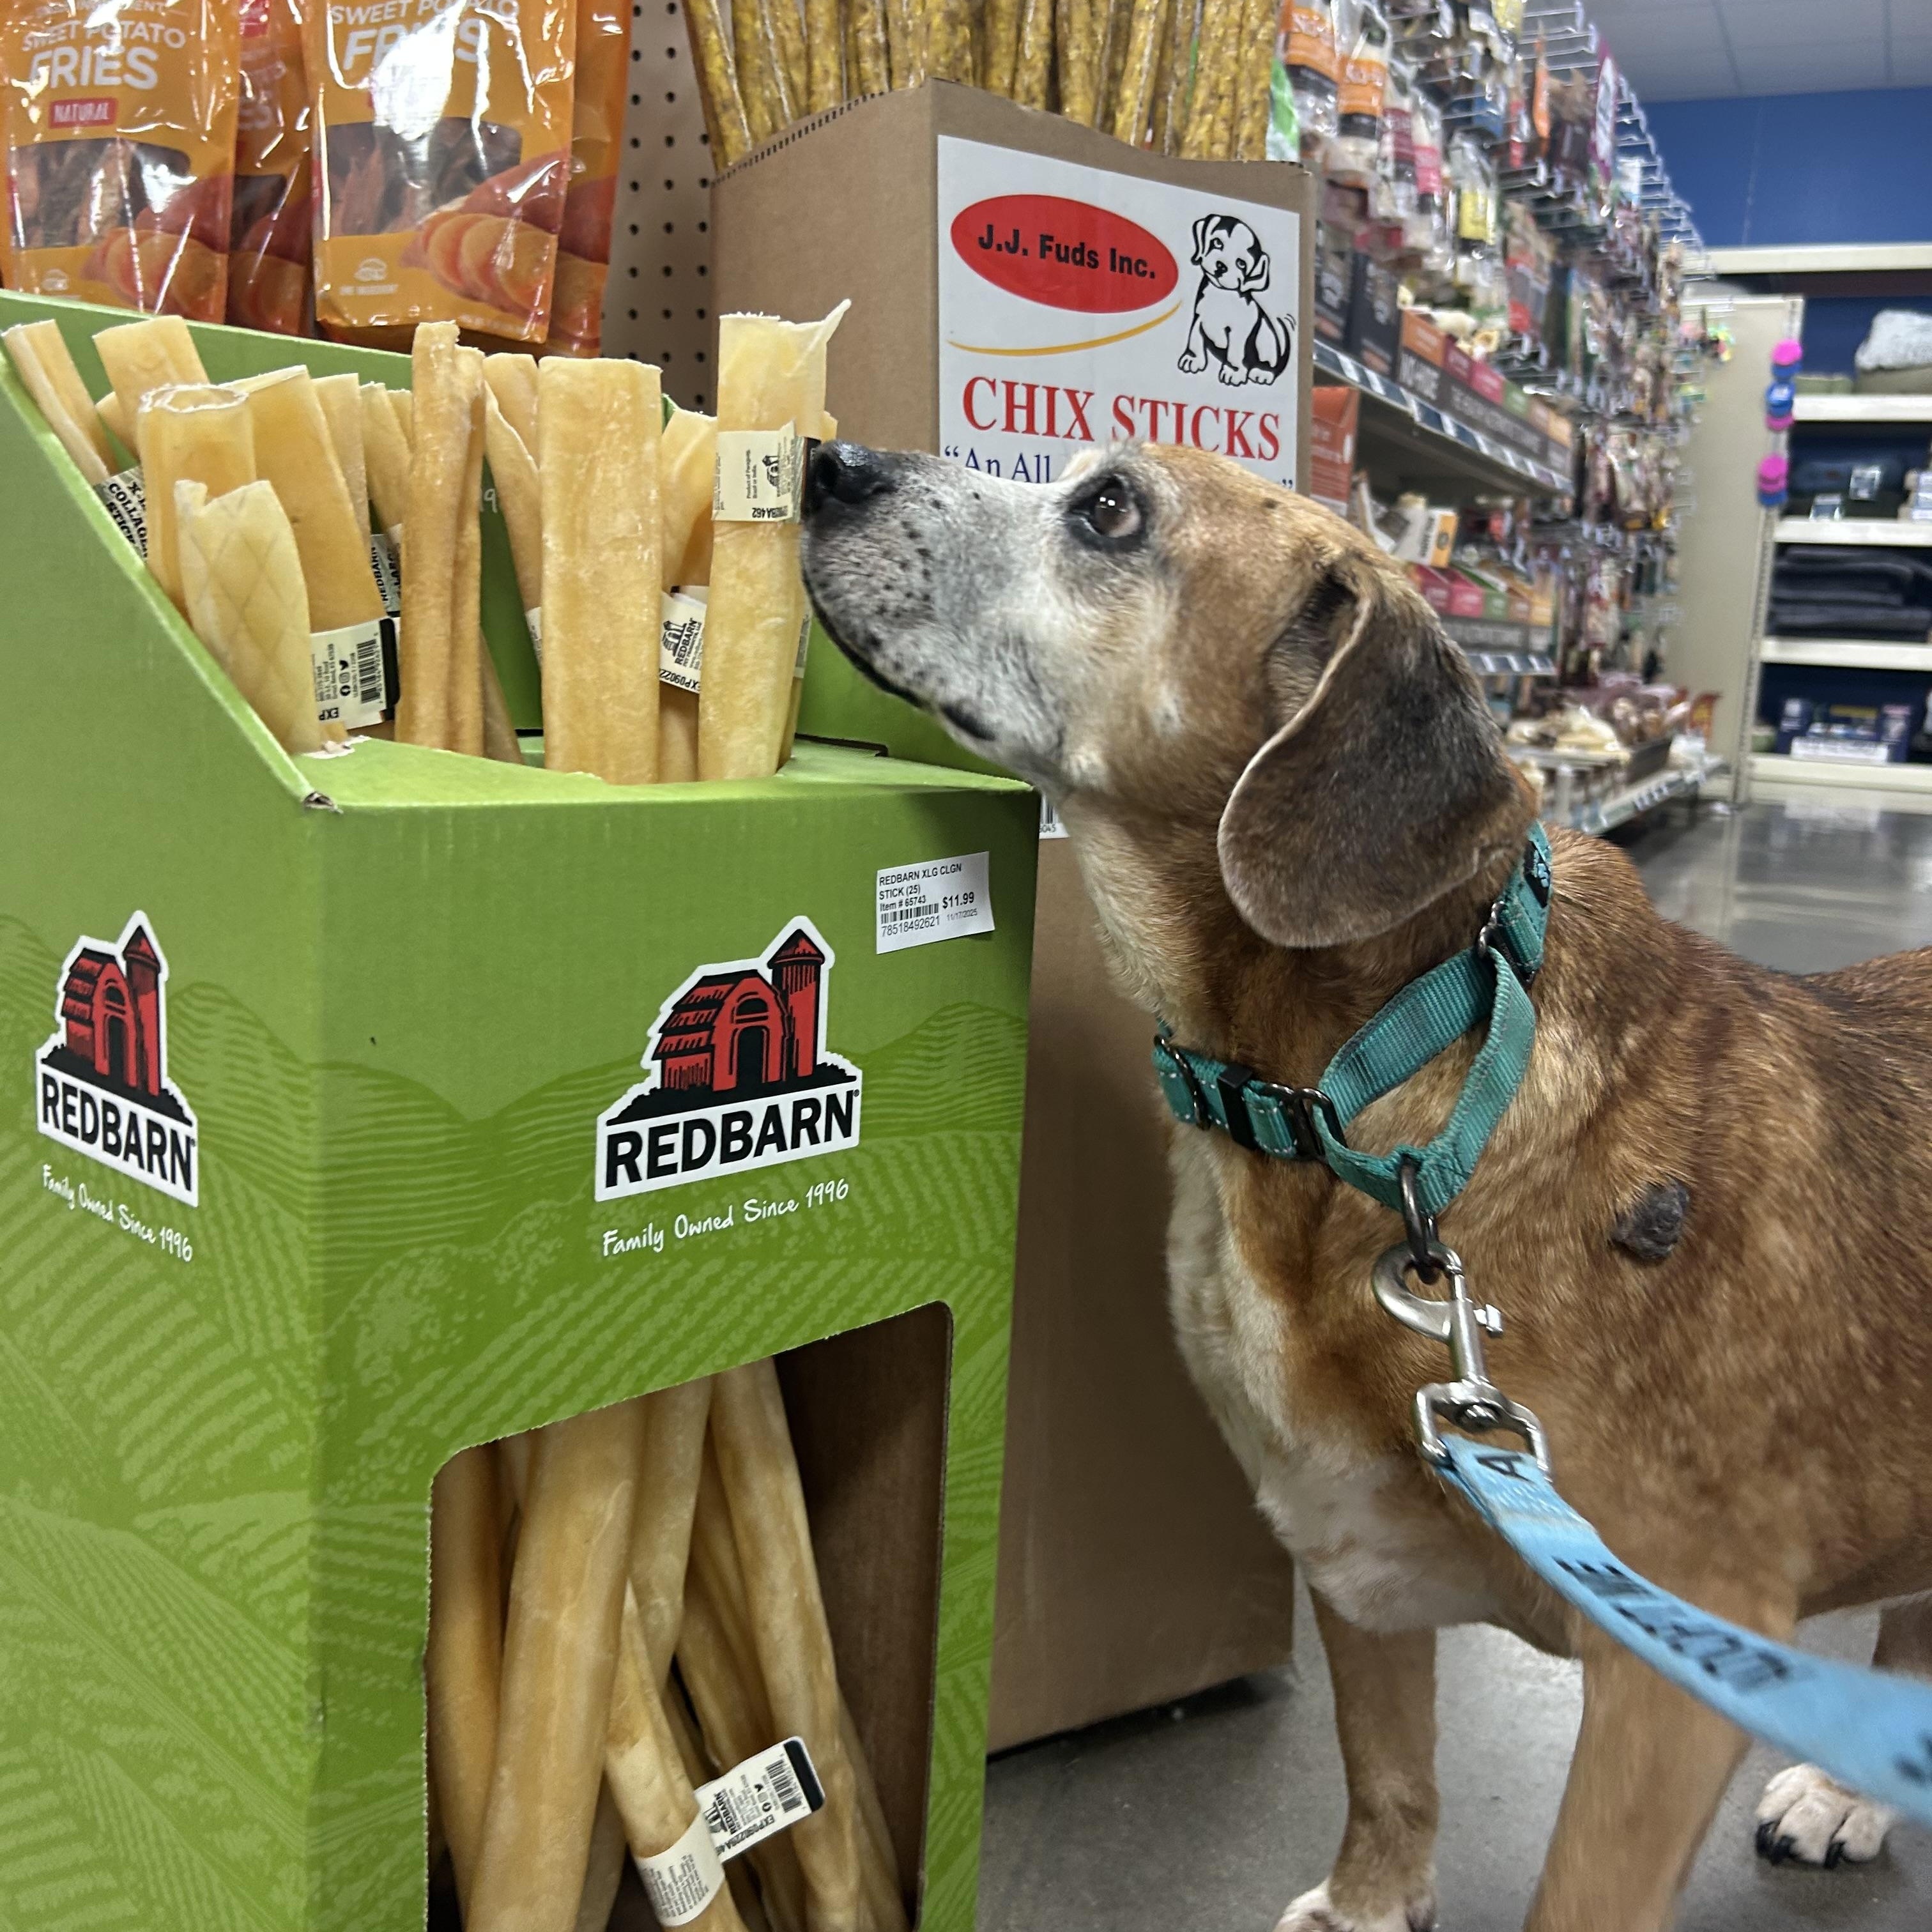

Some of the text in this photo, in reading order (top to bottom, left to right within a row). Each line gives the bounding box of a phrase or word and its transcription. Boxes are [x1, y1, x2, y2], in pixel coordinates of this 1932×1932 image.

[332, 1, 409, 25] SWEET
[22, 20, 81, 51] SWEET
[344, 19, 490, 70] FRS
[30, 45, 158, 89] FRIES
[977, 224, 1156, 279] J.J. Fuds Inc.
[963, 376, 1095, 442] CHIX
[1111, 395, 1280, 462] STICKS
[1012, 452, 1051, 484] All
[674, 619, 697, 665] REDBARN
[318, 707, 339, 721] EXP
[879, 863, 963, 887] REDBARN XLG CLGN
[879, 884, 921, 900] STICK (25)
[880, 902, 896, 912] Item
[905, 895, 926, 907] 65743
[942, 891, 975, 909] $11.99
[882, 915, 940, 937] 78518492621
[947, 908, 977, 921] 11/17/2025
[41, 1072, 192, 1192] REDBARN
[605, 1089, 855, 1188] REDBARN
[42, 1164, 193, 1263] Family Owned Since 1996
[602, 1177, 850, 1257] Family Owned Since 1996
